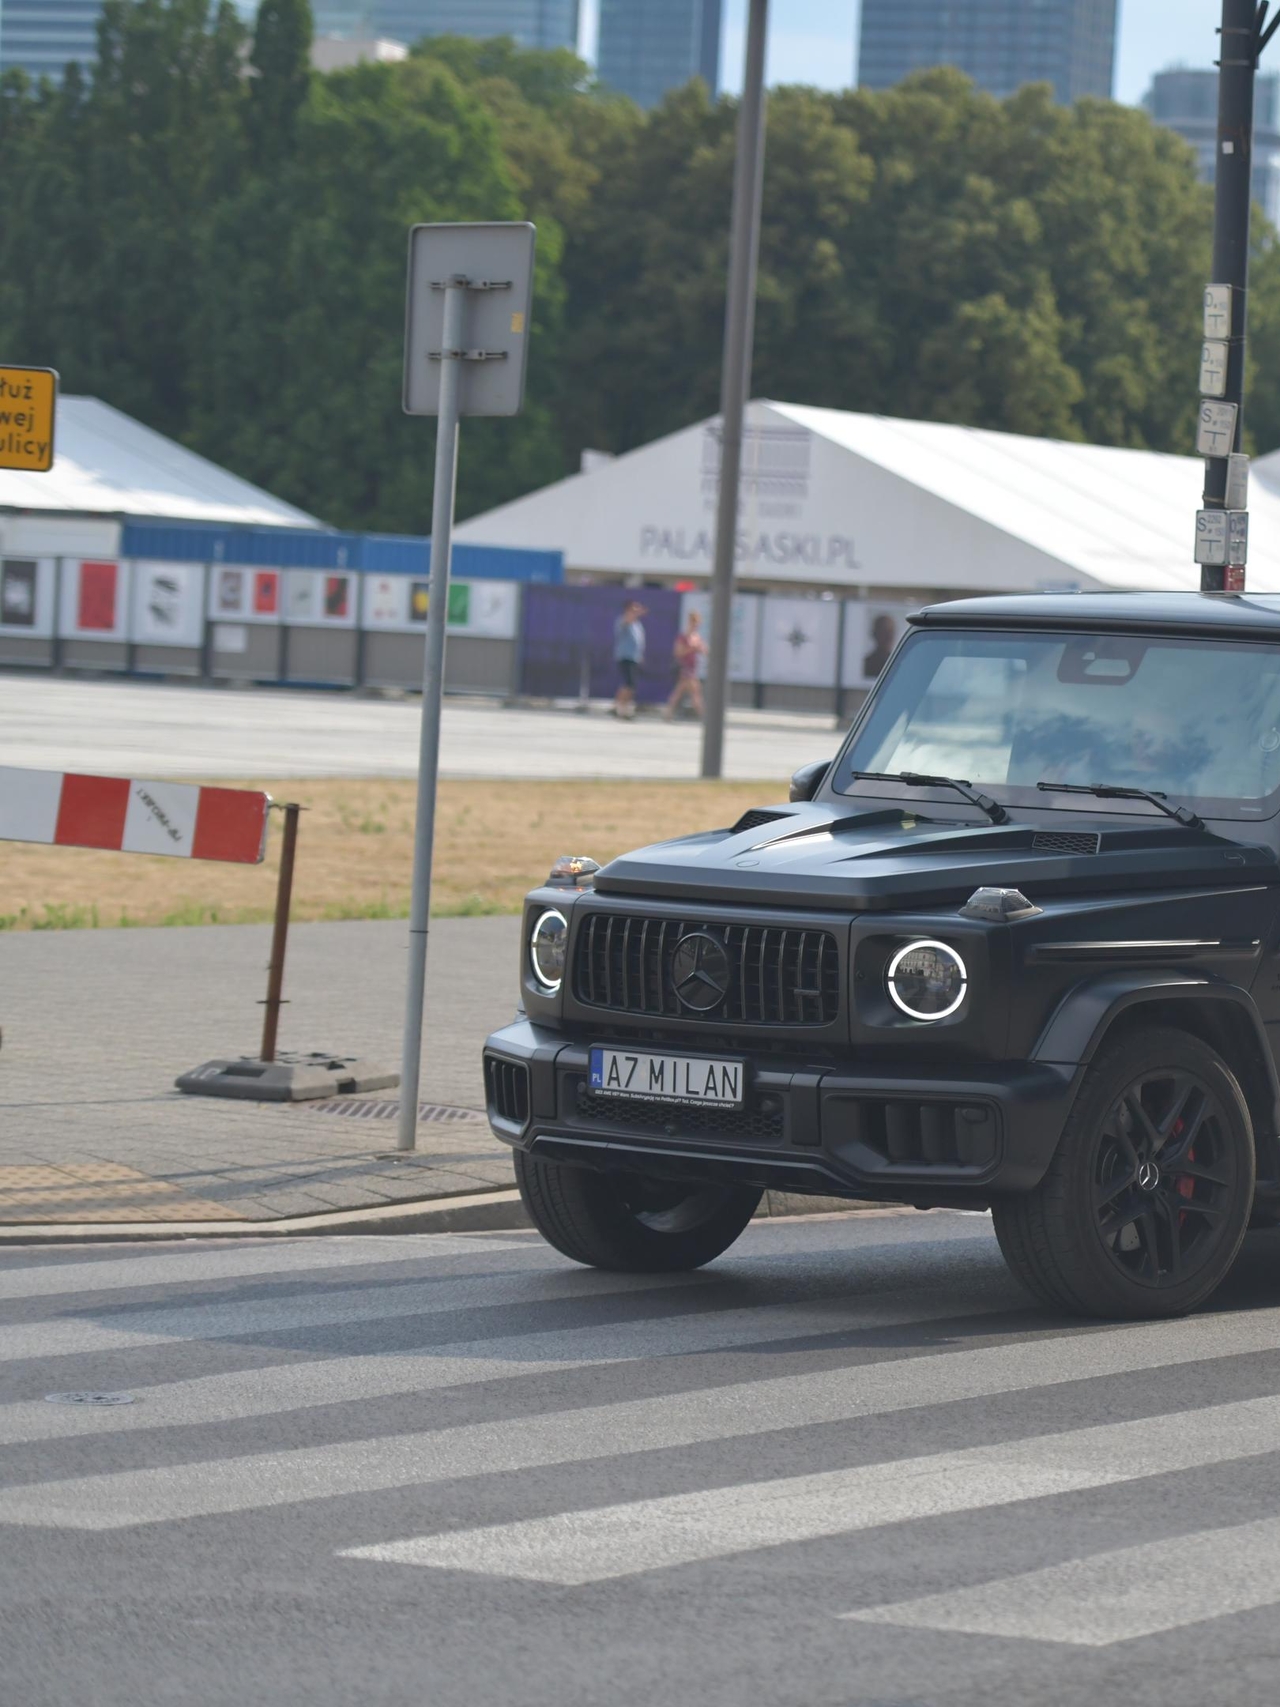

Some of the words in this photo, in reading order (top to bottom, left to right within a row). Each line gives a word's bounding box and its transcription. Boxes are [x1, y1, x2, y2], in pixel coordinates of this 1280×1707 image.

[640, 525, 862, 570] PALASASKI.PL
[592, 1072, 602, 1083] PL
[607, 1055, 639, 1089] A7
[650, 1059, 738, 1099] MILAN
